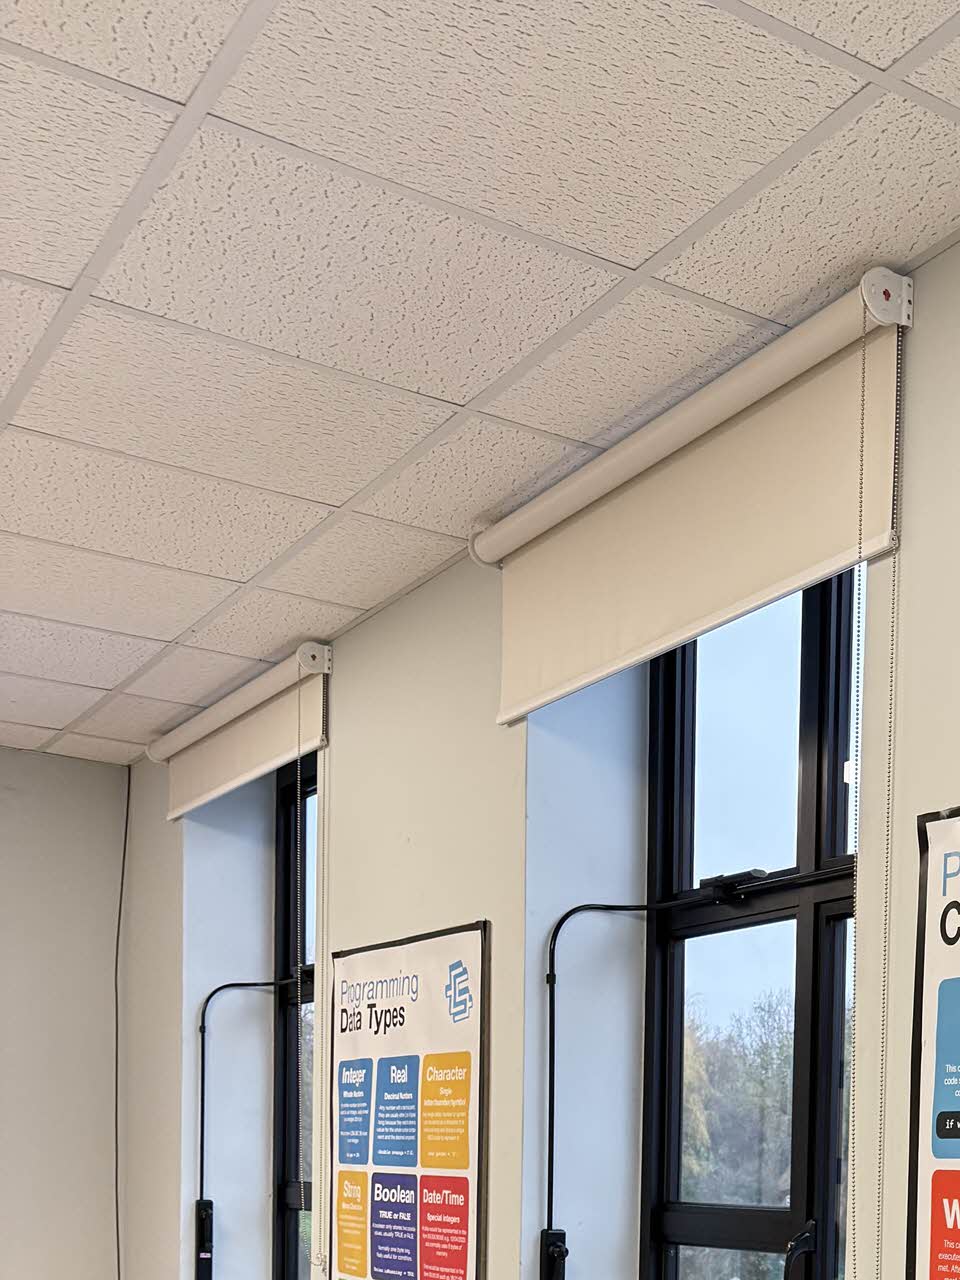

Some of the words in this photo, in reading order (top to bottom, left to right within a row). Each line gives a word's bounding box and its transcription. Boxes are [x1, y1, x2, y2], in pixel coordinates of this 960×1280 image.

[341, 970, 419, 1007] Programming
[340, 1008, 362, 1034] Data
[367, 1003, 405, 1035] Types
[342, 1067, 366, 1087] Integer
[390, 1064, 408, 1084] Real
[426, 1066, 467, 1082] Character
[945, 1119, 953, 1128] if
[374, 1183, 415, 1204] Boolean
[423, 1189, 465, 1206] Date/Time
